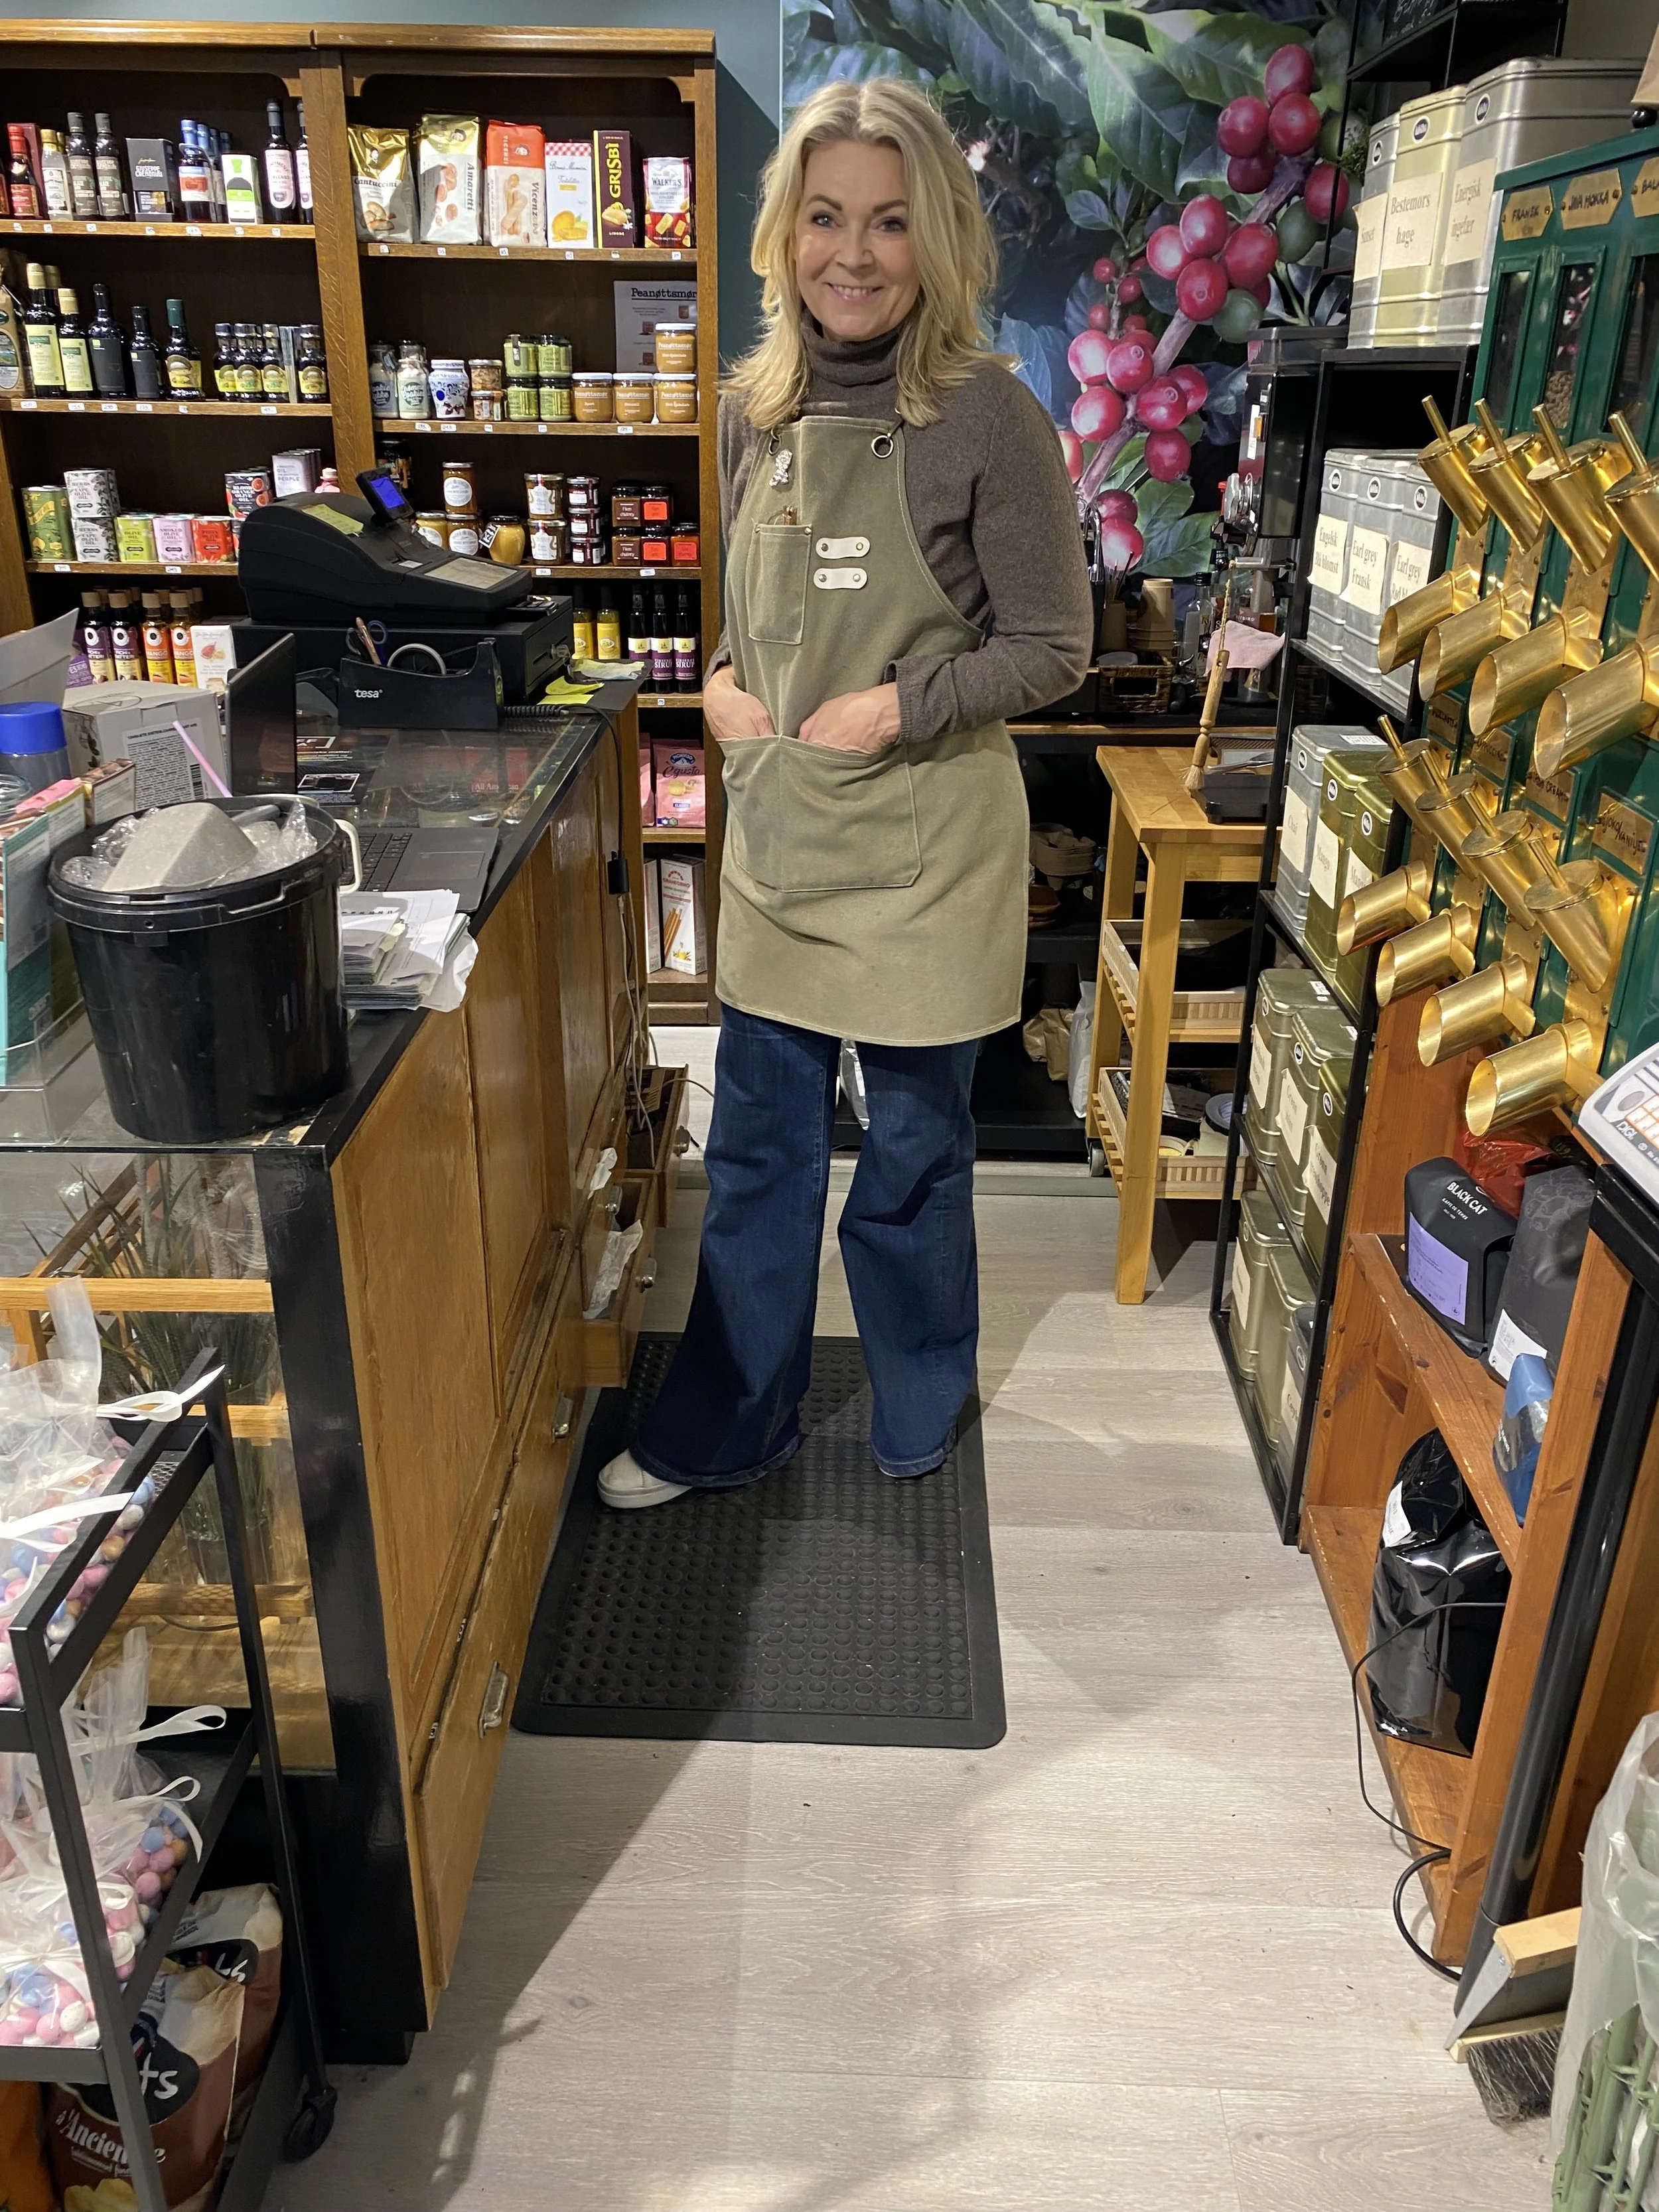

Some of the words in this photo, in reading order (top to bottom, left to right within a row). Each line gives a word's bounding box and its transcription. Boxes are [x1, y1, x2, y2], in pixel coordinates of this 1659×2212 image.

[354, 177, 399, 188] Cantuccini
[467, 162, 475, 211] Amaretti
[652, 177, 682, 186] WALKERS
[1455, 177, 1482, 205] Energisk
[1390, 193, 1431, 214] Bestemors
[1511, 205, 1540, 223] FRANSK
[1396, 226, 1415, 248] hage
[631, 287, 697, 299] Peanøttsmør
[1319, 527, 1338, 547] Engelsk
[1352, 540, 1364, 559] Earl
[1364, 548, 1378, 567] grey
[1322, 554, 1338, 575] blomst
[1396, 555, 1408, 574] Earl
[1407, 563, 1422, 583] grey
[1352, 568, 1372, 590] Fransk
[354, 688, 380, 698] tesa
[1447, 1181, 1471, 1205] BLACK
[1469, 1199, 1488, 1216] CAT
